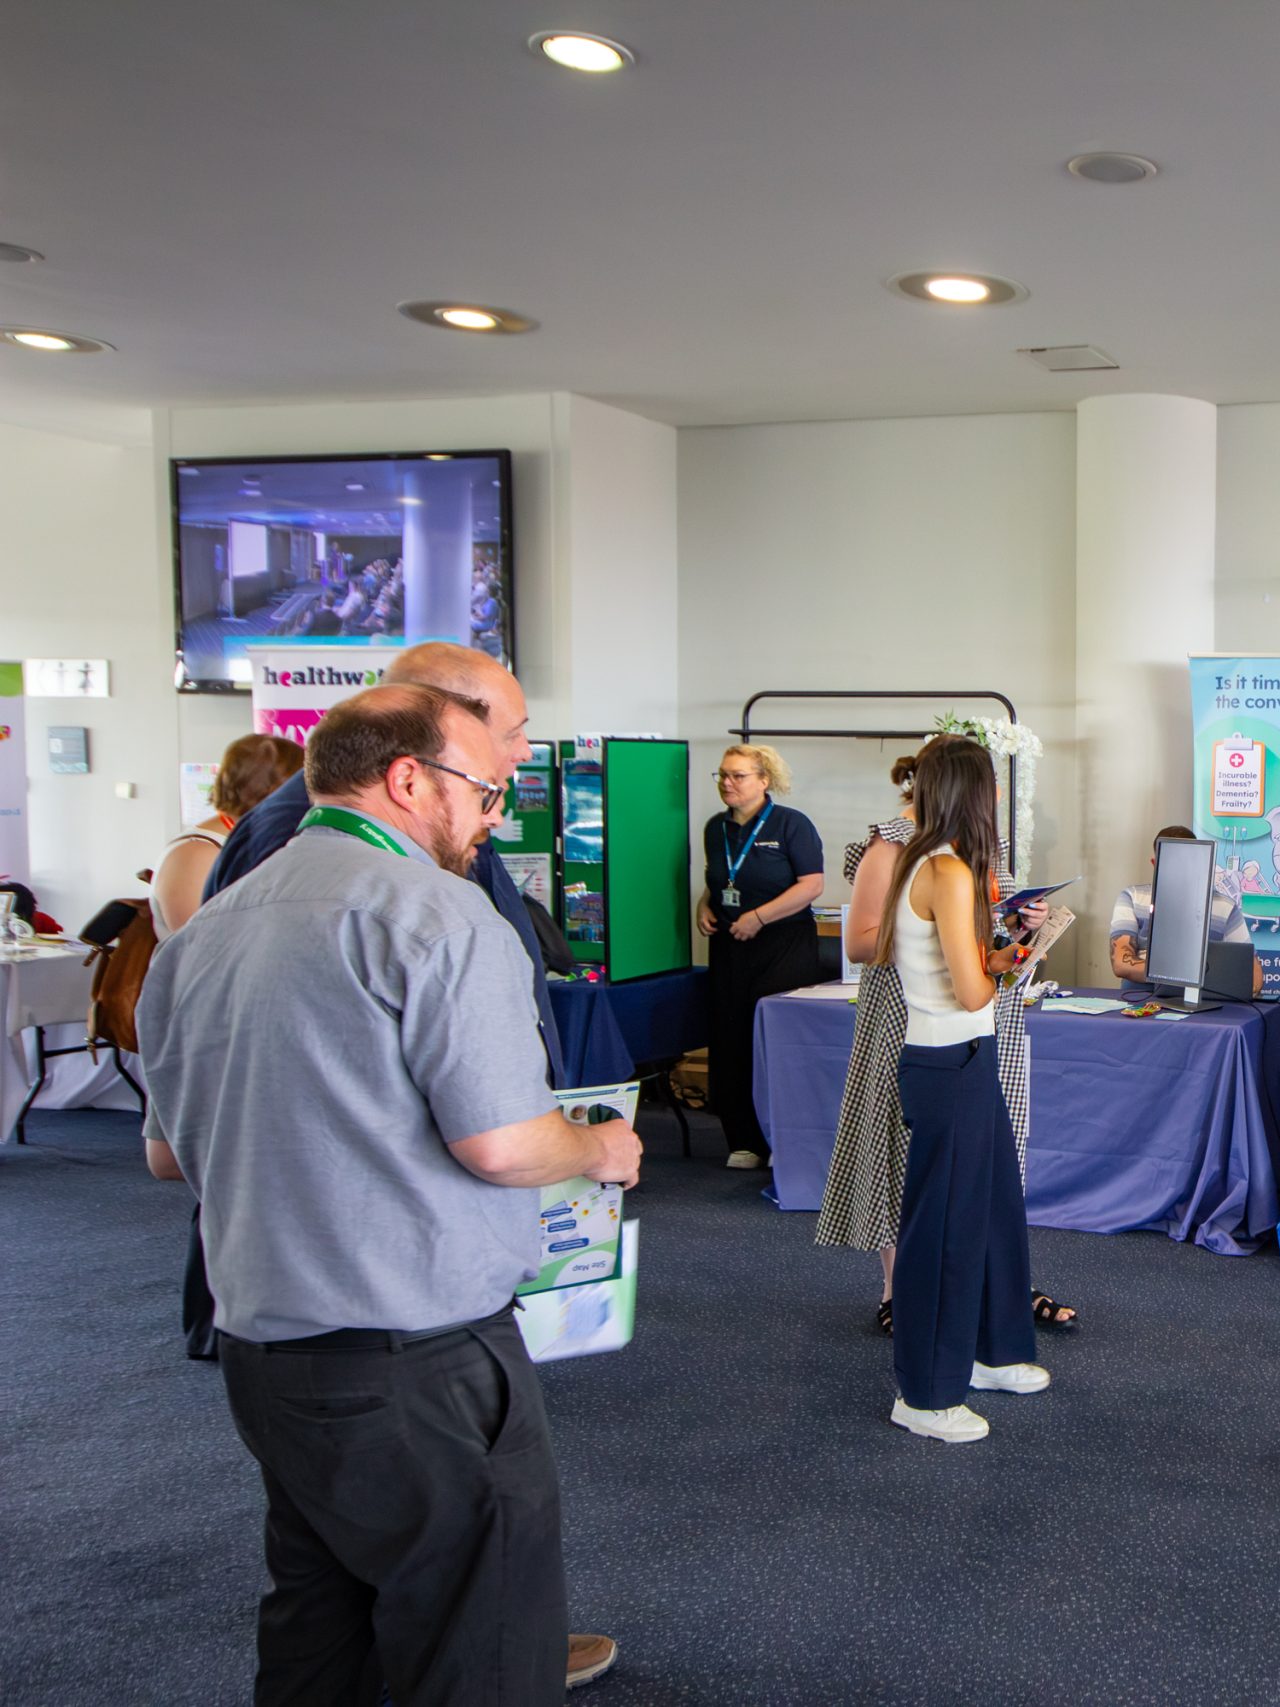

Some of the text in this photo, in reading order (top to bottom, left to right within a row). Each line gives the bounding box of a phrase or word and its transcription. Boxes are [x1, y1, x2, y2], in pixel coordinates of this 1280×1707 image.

[1215, 676, 1232, 690] Is
[1236, 675, 1247, 690] it
[1215, 695, 1240, 709] the
[1218, 771, 1257, 779] Incurable
[1222, 780, 1251, 788] illness?
[1216, 790, 1259, 798] Dementia?
[1221, 800, 1252, 808] Frailty?
[1258, 956, 1271, 967] he
